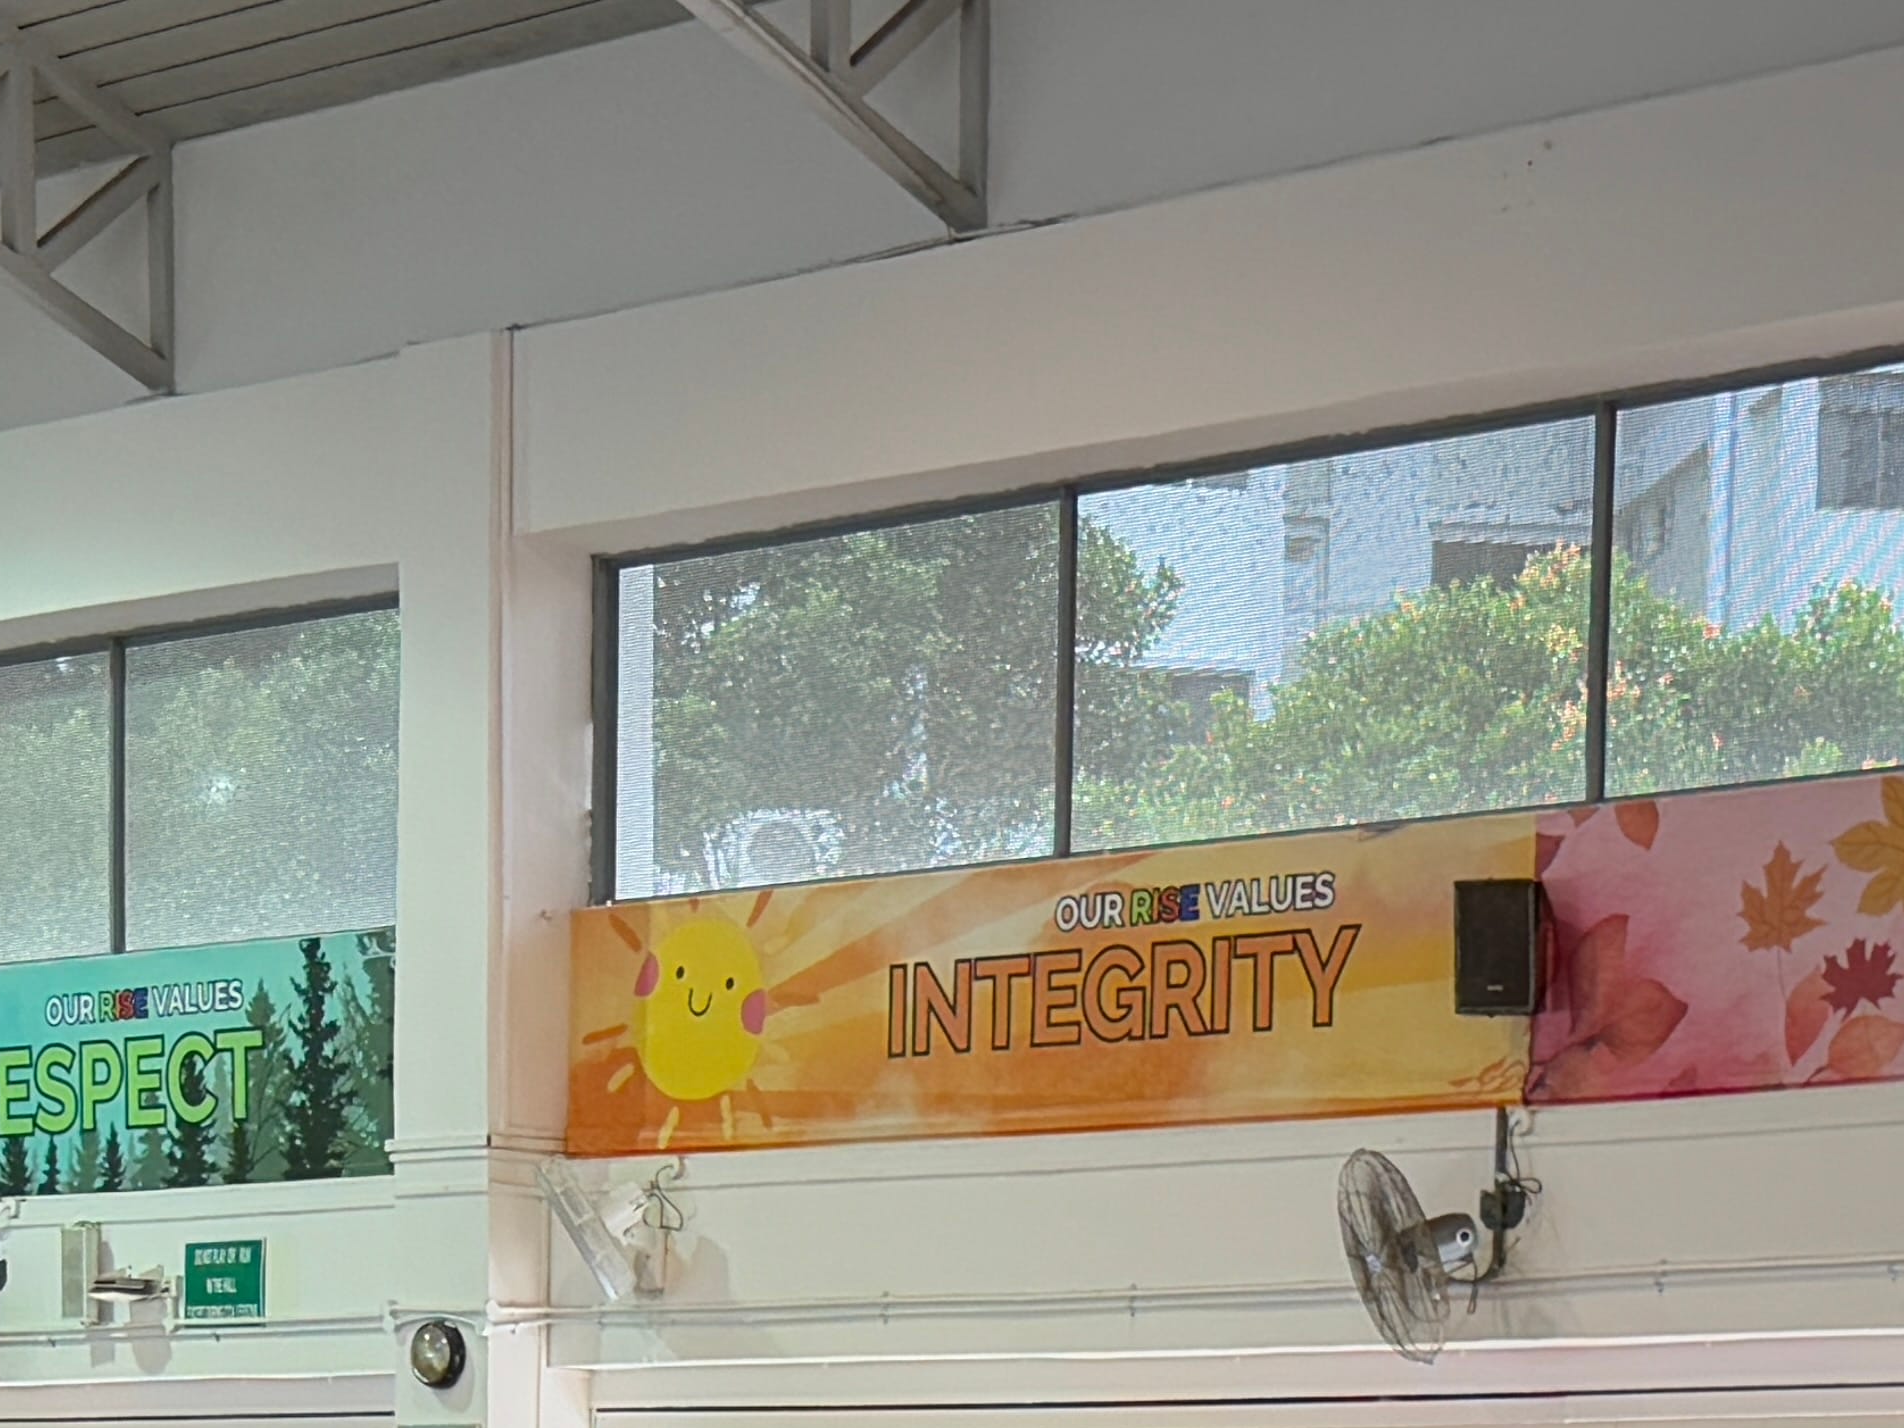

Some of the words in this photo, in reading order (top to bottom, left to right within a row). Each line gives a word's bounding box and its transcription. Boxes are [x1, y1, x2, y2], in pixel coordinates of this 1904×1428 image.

[1055, 890, 1125, 932] OUR
[1130, 883, 1201, 928] RISE
[1206, 871, 1336, 920] VALUES
[45, 991, 95, 1027] OUR
[99, 986, 149, 1023] RISE
[150, 978, 243, 1019] VALUES
[887, 924, 1362, 1059] INTEGRITY
